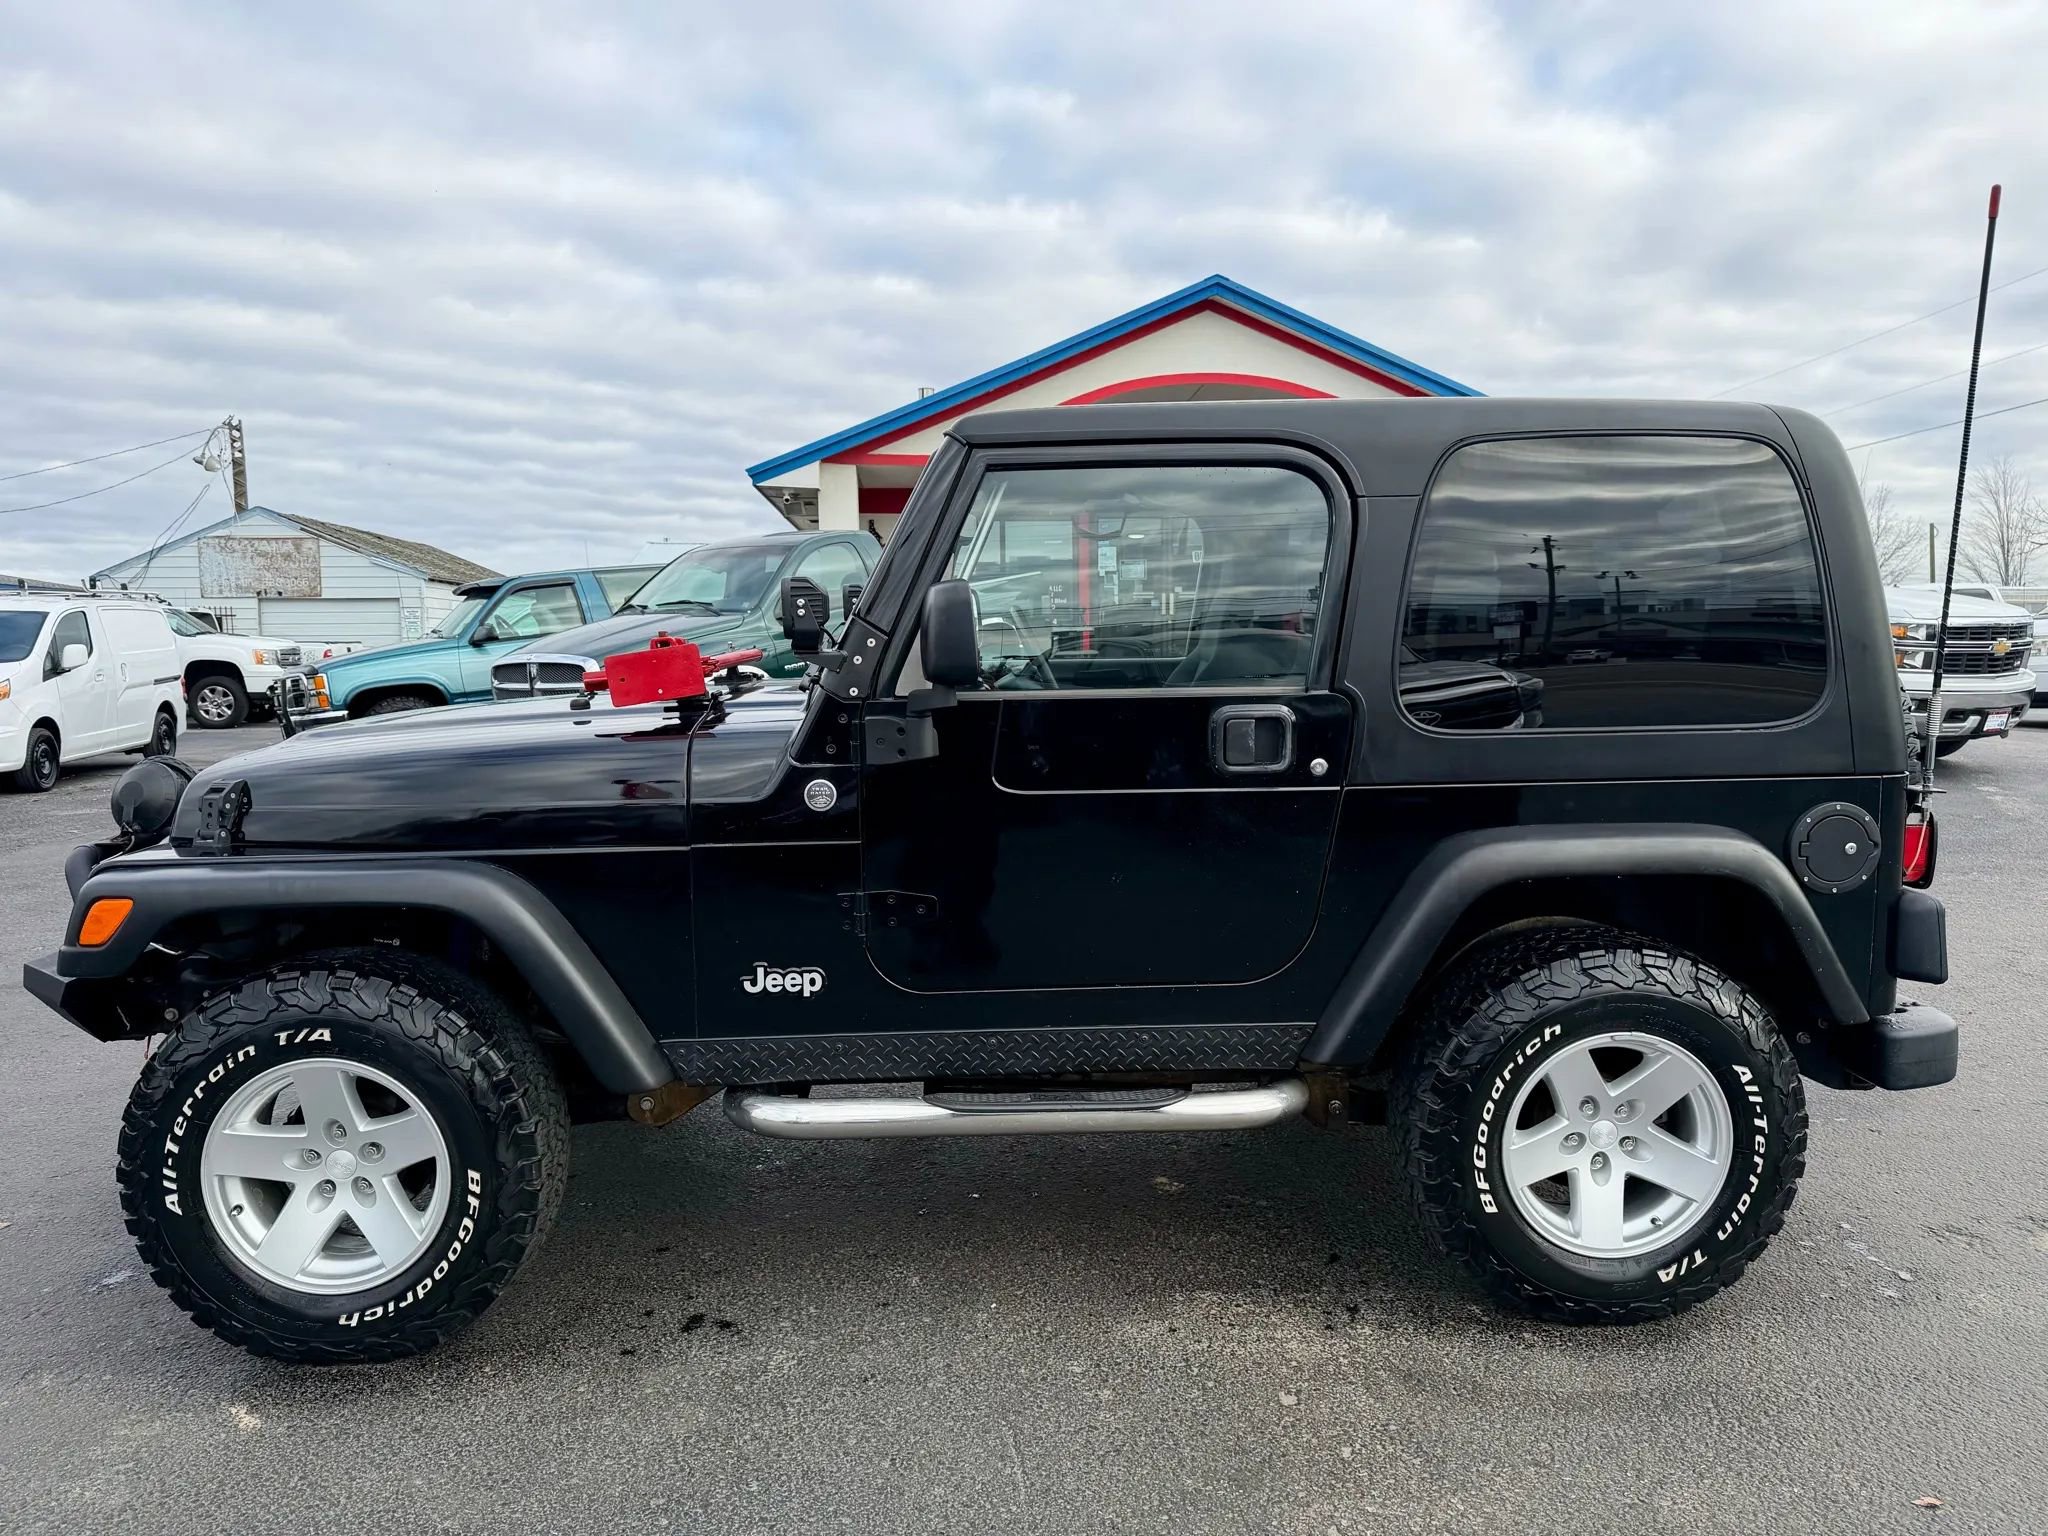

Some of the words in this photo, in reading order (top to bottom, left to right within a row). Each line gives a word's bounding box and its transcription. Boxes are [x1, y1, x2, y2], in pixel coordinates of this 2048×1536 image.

[742, 964, 825, 998] Jeep
[159, 1042, 258, 1217] All-Terrain
[274, 1027, 332, 1047] T/A
[1472, 1022, 1563, 1215] BFGoodrich
[1716, 1063, 1770, 1242] All-Terrain
[338, 1166, 483, 1329] BFGoodrich
[1657, 1246, 1709, 1284] T/A
